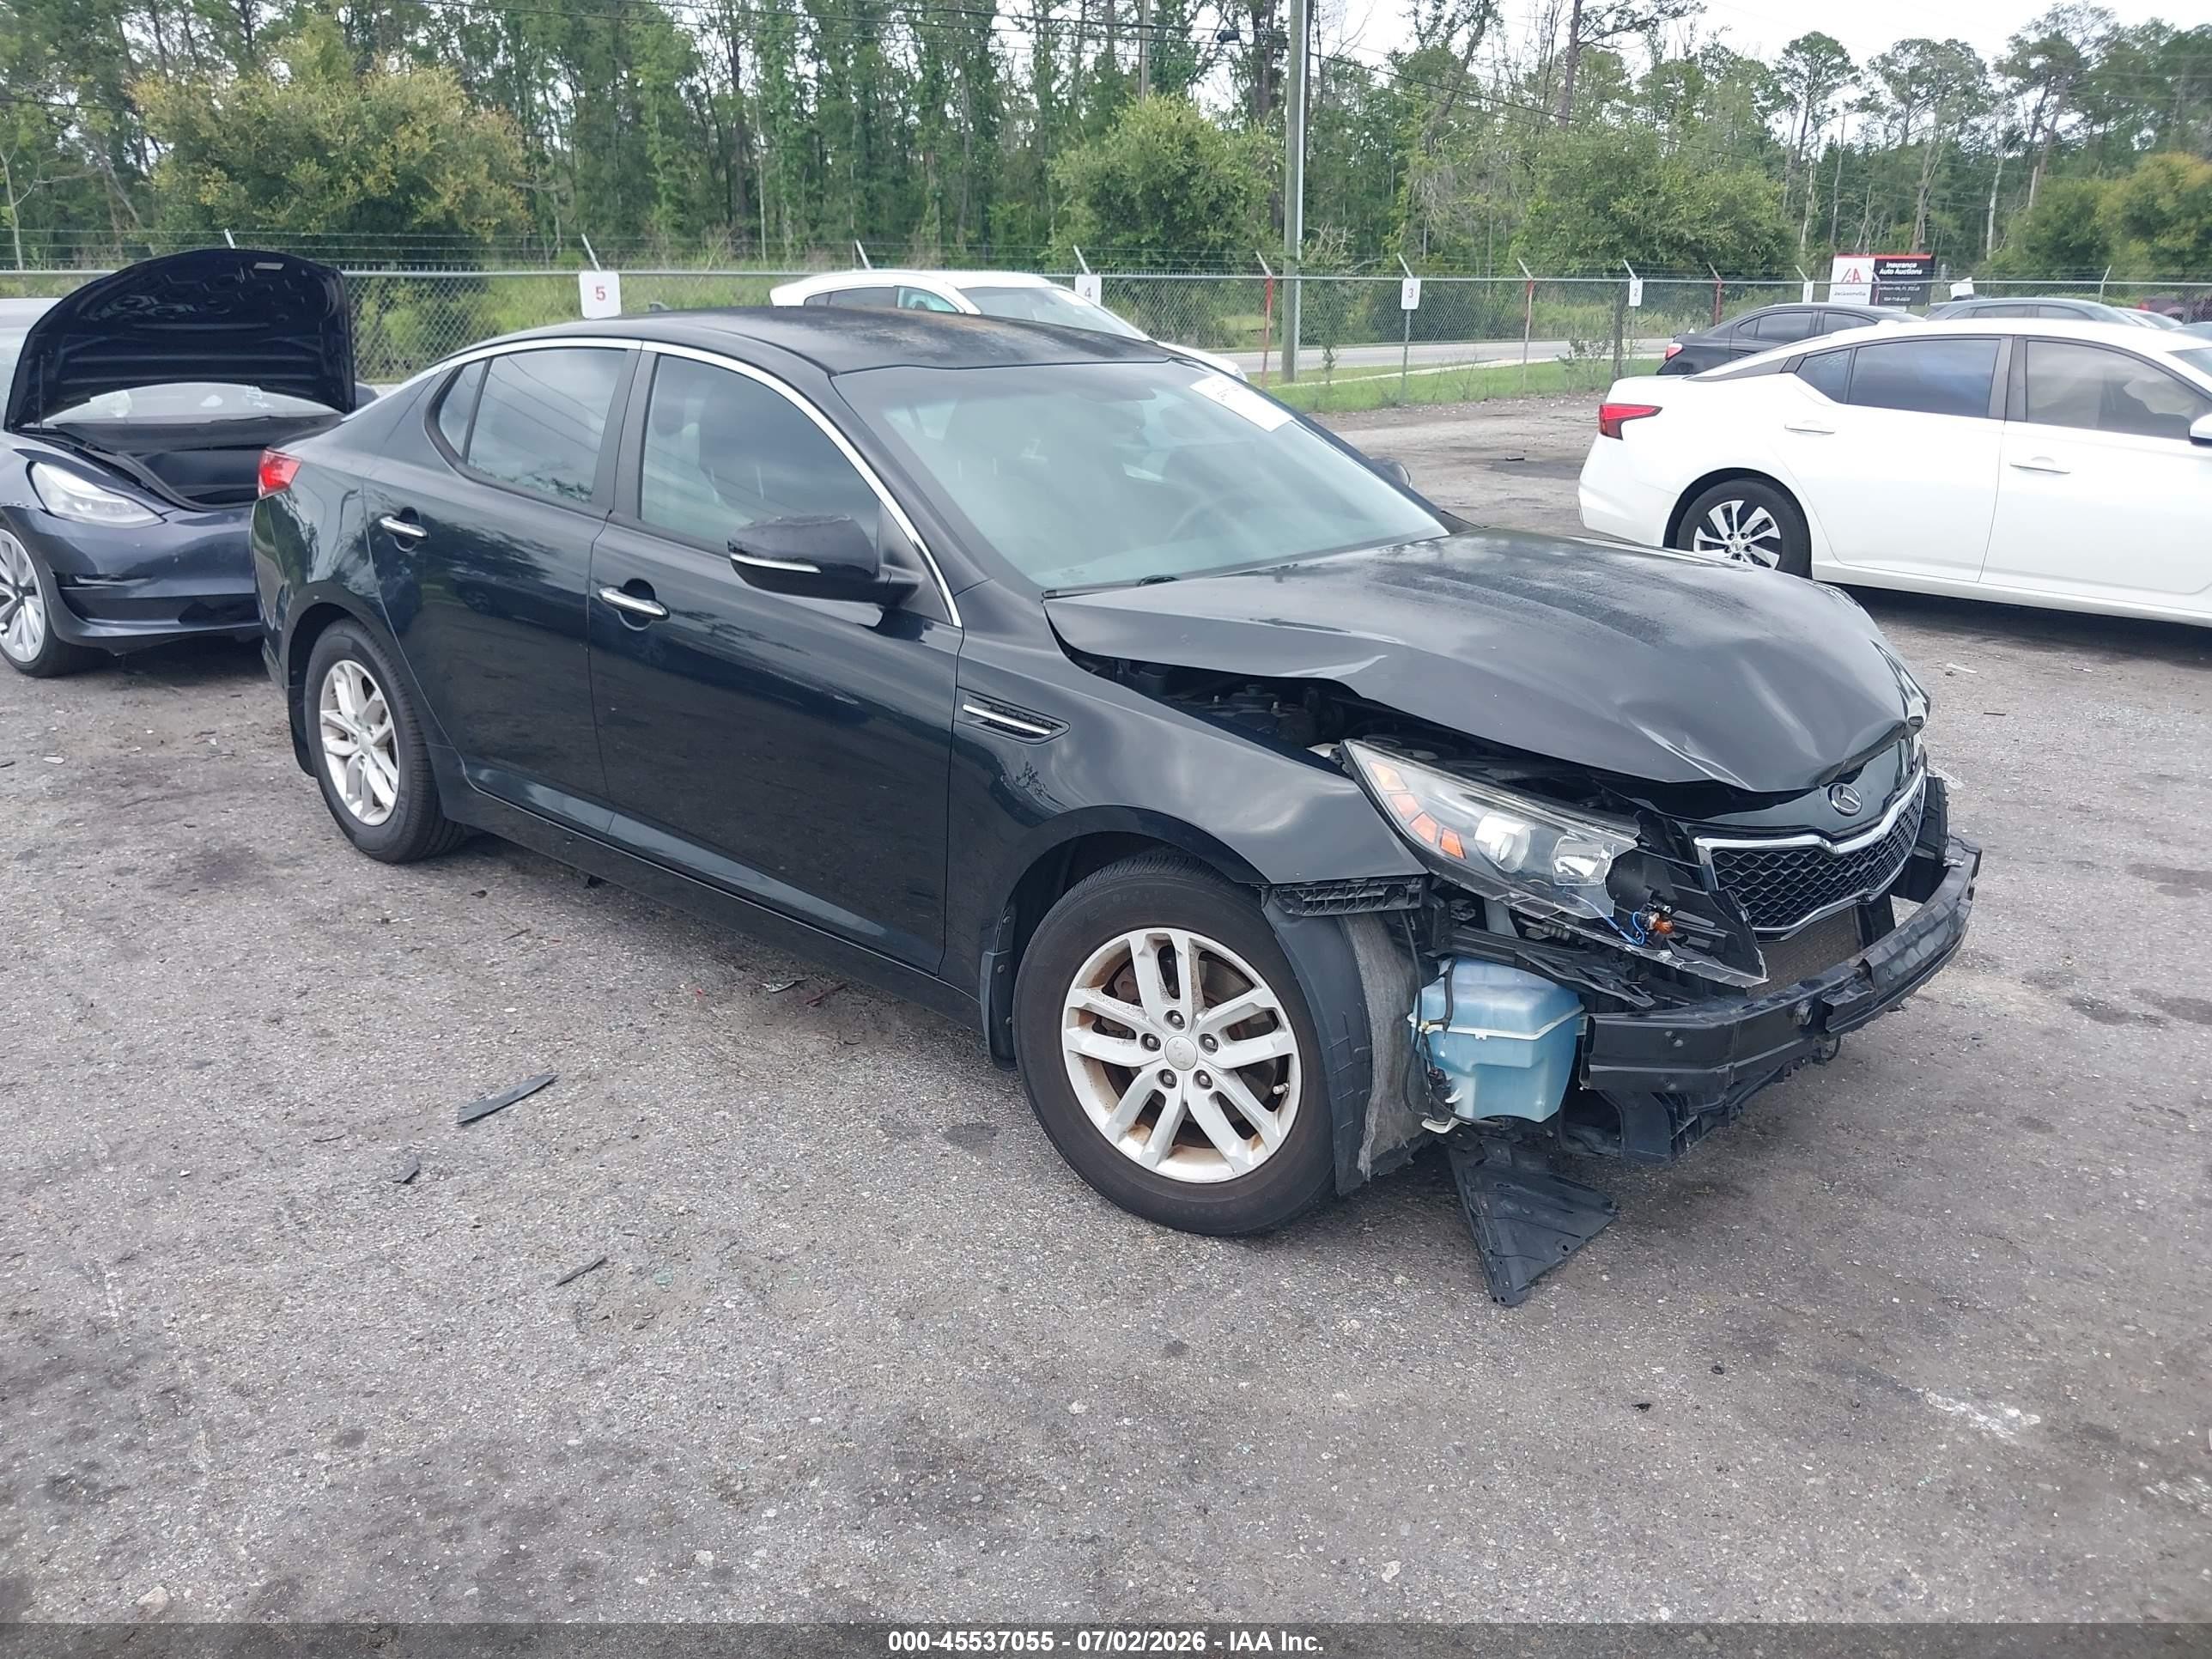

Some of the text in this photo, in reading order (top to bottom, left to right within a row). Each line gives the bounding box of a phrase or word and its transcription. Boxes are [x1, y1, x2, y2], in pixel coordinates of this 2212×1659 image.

[595, 285, 606, 301] 5
[1085, 286, 1092, 299] 4
[1408, 288, 1414, 299] 3
